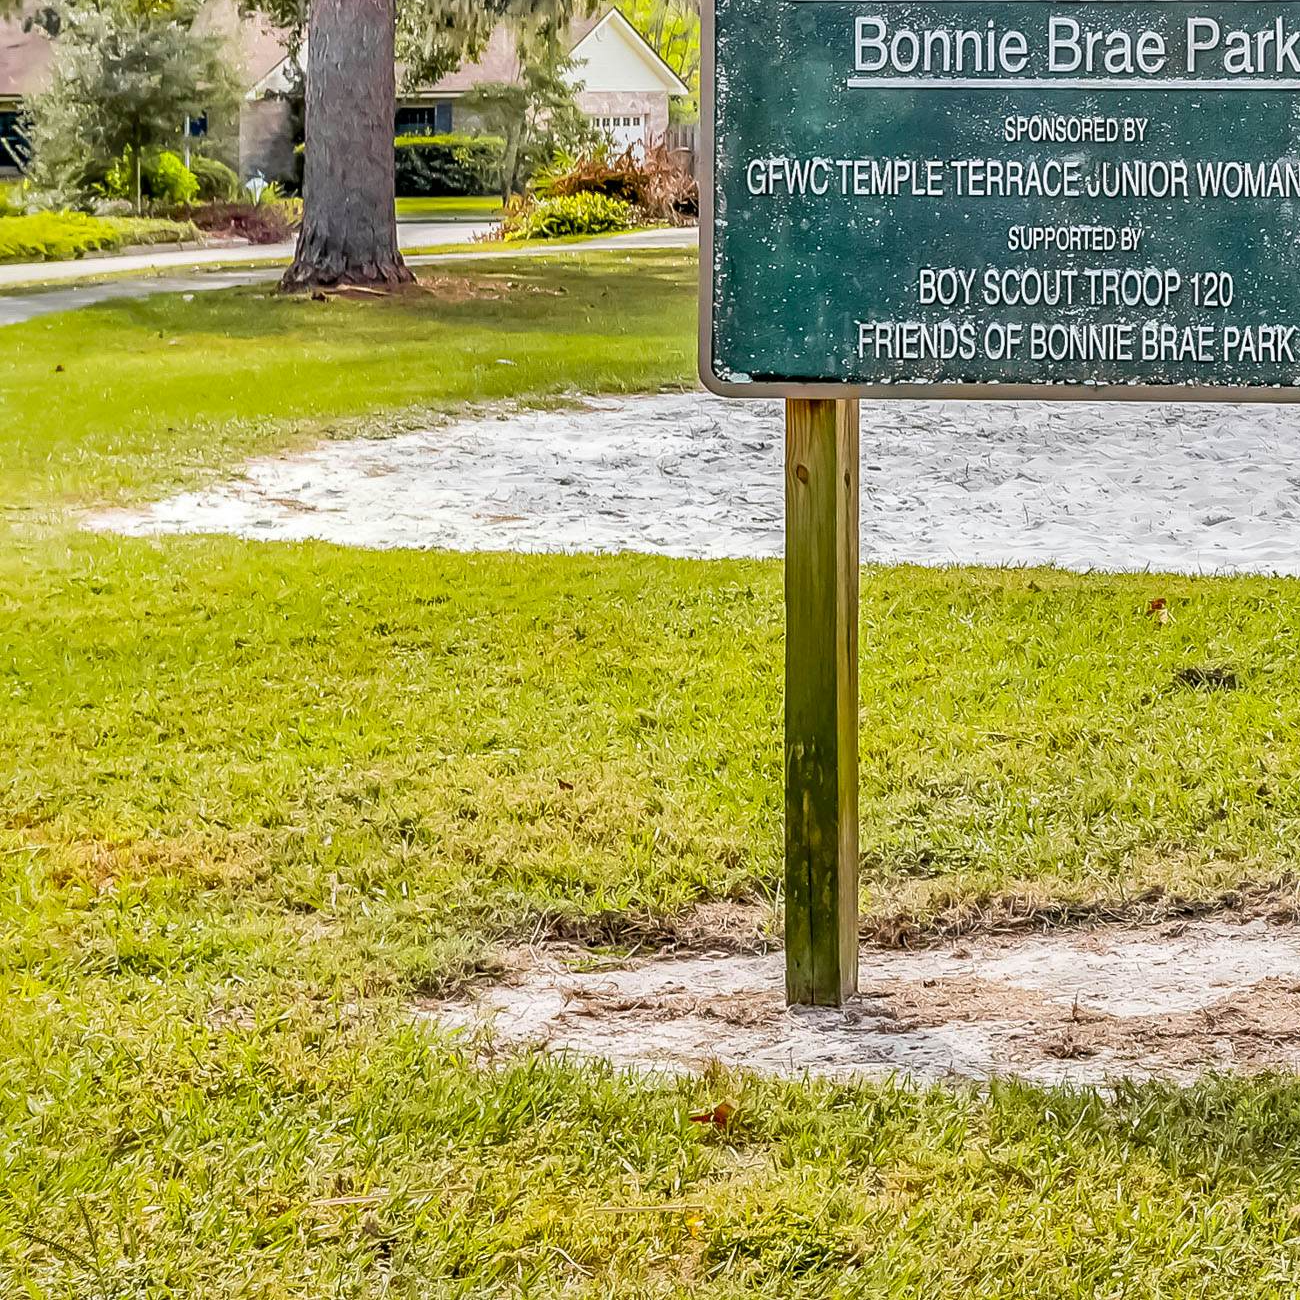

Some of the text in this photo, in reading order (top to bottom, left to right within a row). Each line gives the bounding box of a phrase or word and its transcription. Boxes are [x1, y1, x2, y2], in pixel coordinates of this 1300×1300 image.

[854, 17, 1028, 73] Bonnie
[1048, 18, 1165, 74] Brae
[1004, 117, 1148, 142] SPONSORED BY
[746, 159, 832, 196] GFWC
[836, 160, 944, 197] TEMPLE
[951, 161, 1080, 198] TERRACE
[1086, 161, 1189, 198] JUNIOR
[1008, 226, 1142, 251] SUPPORTED BY
[919, 270, 1234, 308] BOY SCOUT TROOP 120
[858, 324, 1298, 363] FRIENDS OF BONNIE BRAE PARK
